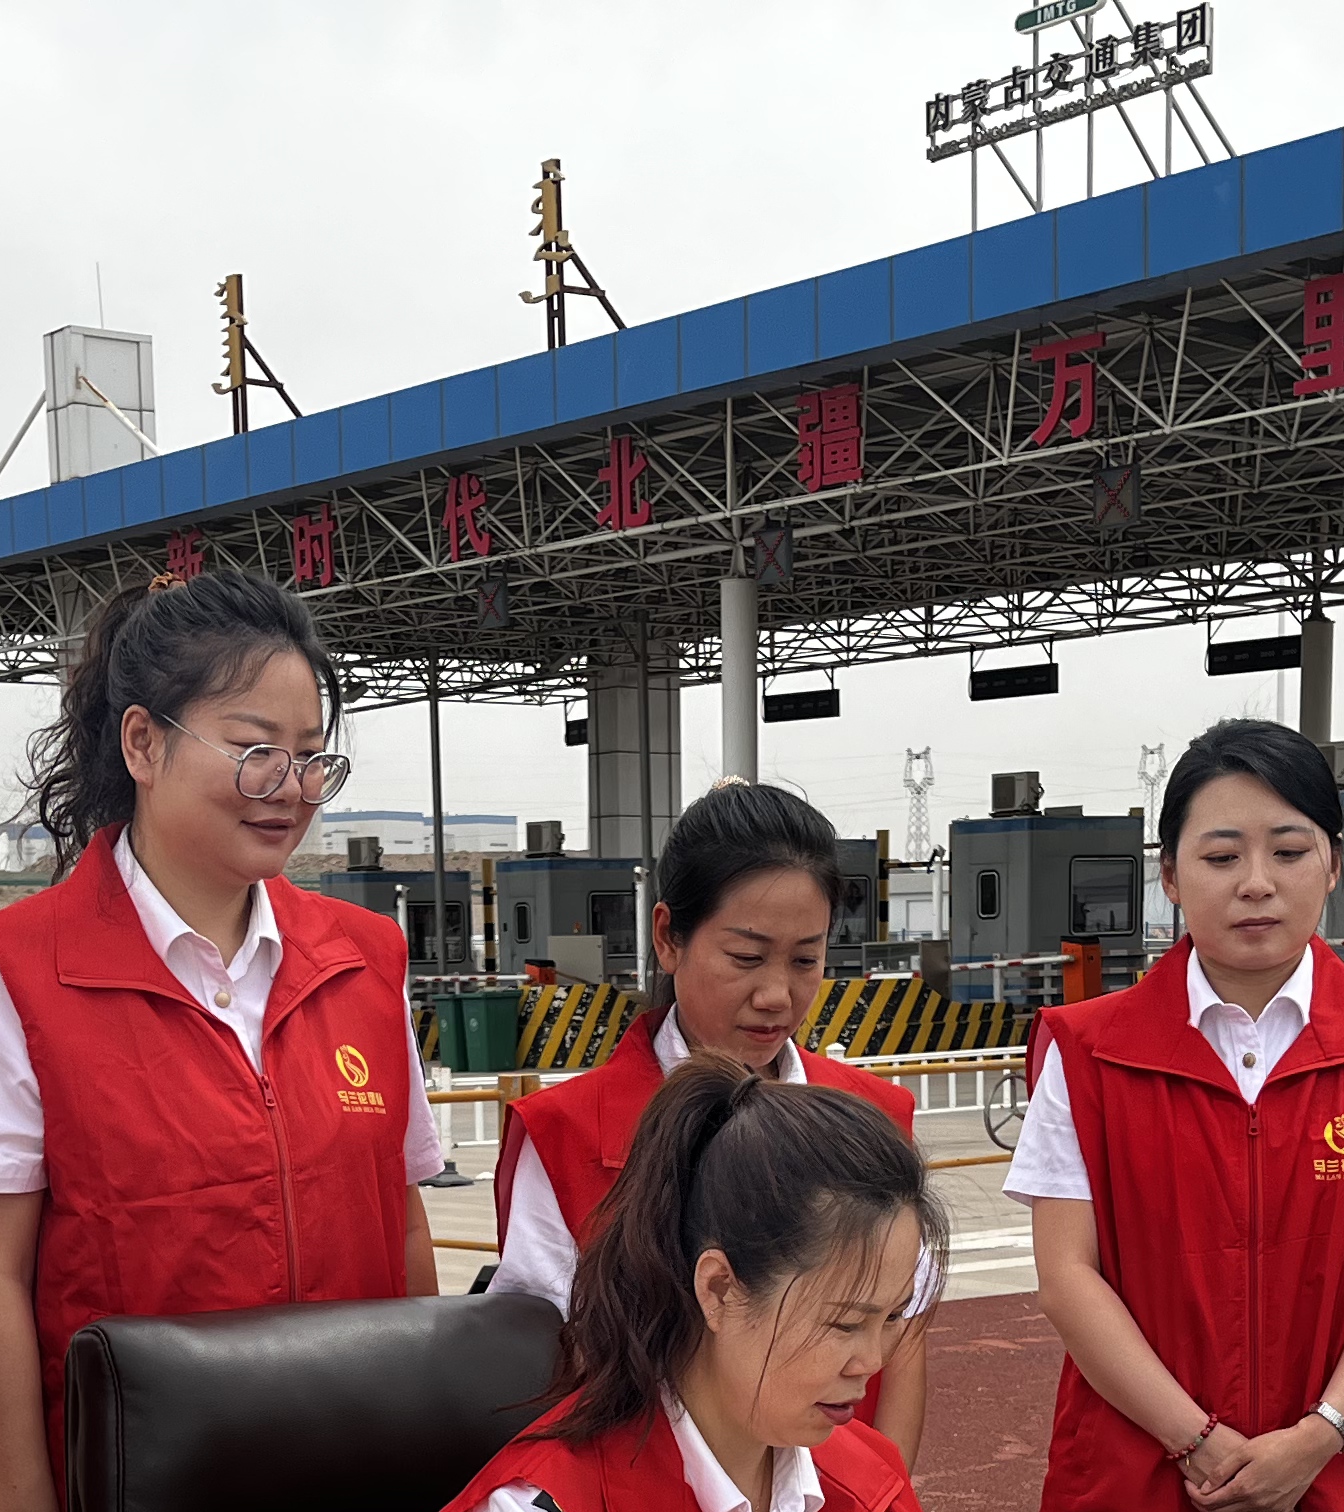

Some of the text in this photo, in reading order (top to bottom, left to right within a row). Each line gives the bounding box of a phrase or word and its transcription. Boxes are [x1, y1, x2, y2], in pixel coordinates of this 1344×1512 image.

[1036, 0, 1076, 24] IMTG
[926, 3, 1210, 137] 内蒙古交通集团
